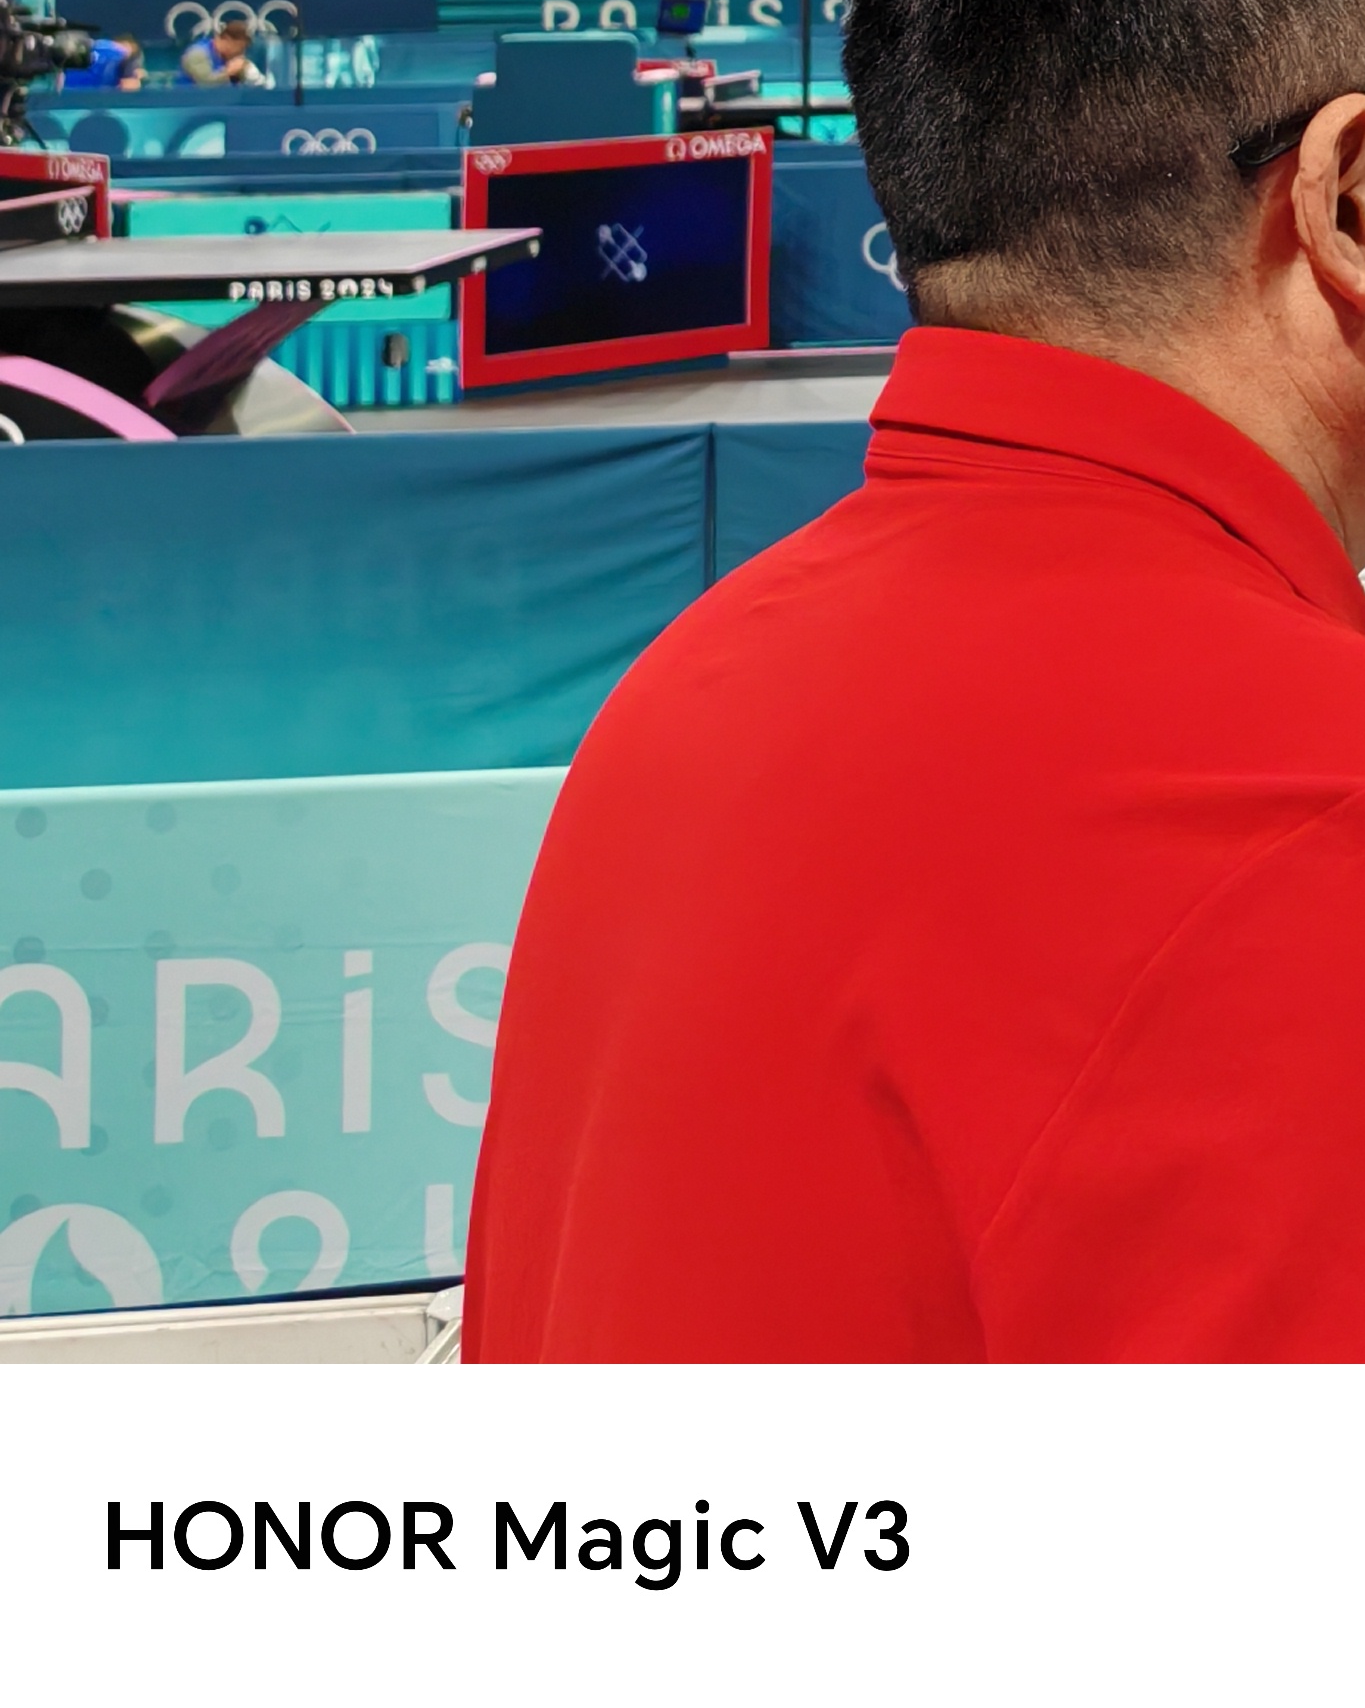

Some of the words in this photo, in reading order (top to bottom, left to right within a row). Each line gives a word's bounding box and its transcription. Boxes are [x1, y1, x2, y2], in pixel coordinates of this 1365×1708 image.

[690, 131, 767, 159] OMEGA
[61, 157, 104, 181] OMEGA
[319, 277, 394, 301] 2024
[0, 942, 514, 1150] ARiS
